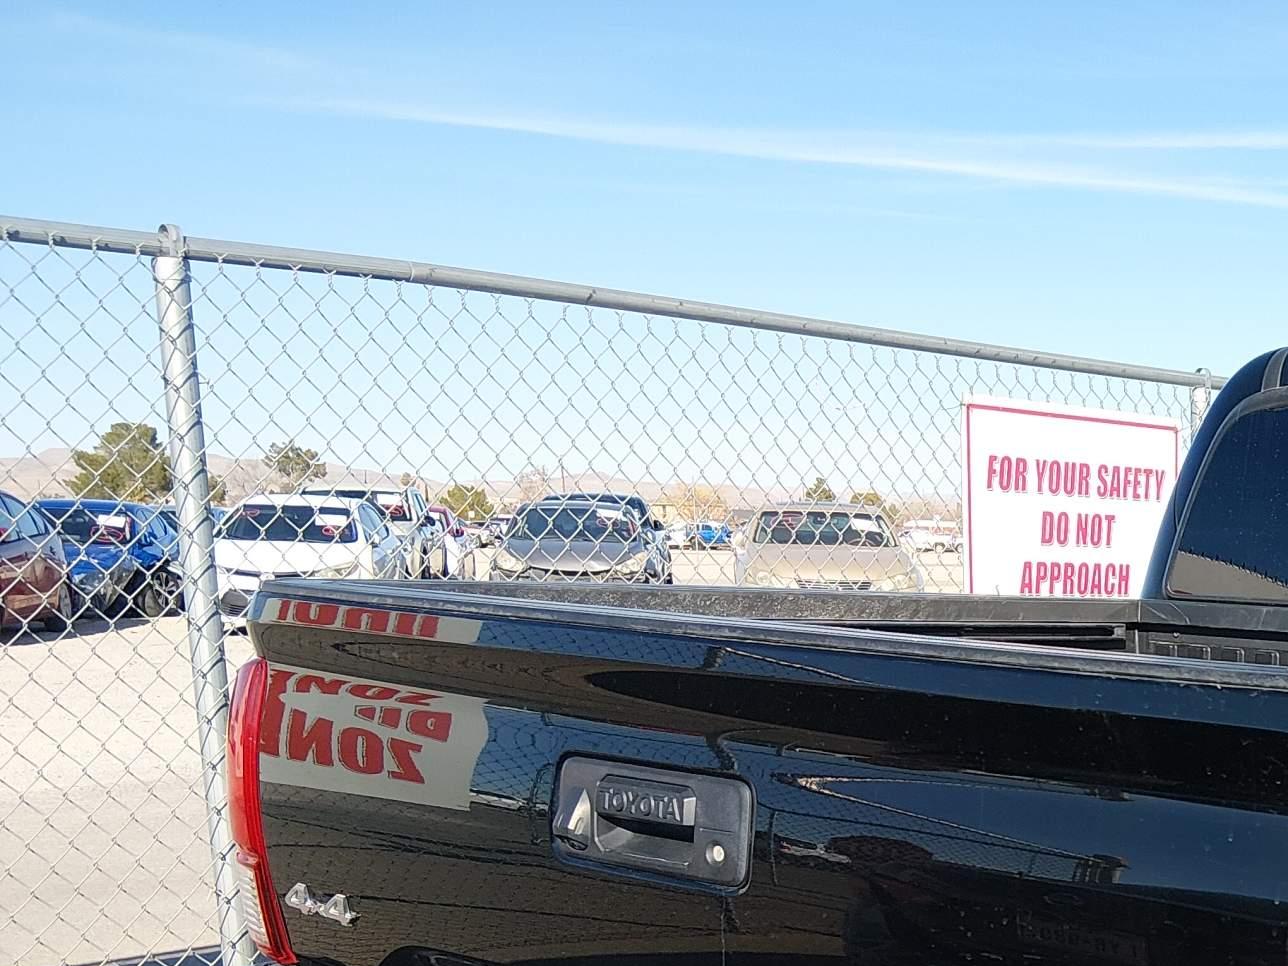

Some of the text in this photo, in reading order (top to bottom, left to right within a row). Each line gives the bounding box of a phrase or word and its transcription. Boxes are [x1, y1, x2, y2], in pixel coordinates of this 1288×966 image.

[987, 455, 1166, 502] FOR YOUR SAFETY
[1041, 511, 1116, 548] DO NOT
[1020, 561, 1131, 597] APPROACH
[600, 788, 681, 822] TOYOTA
